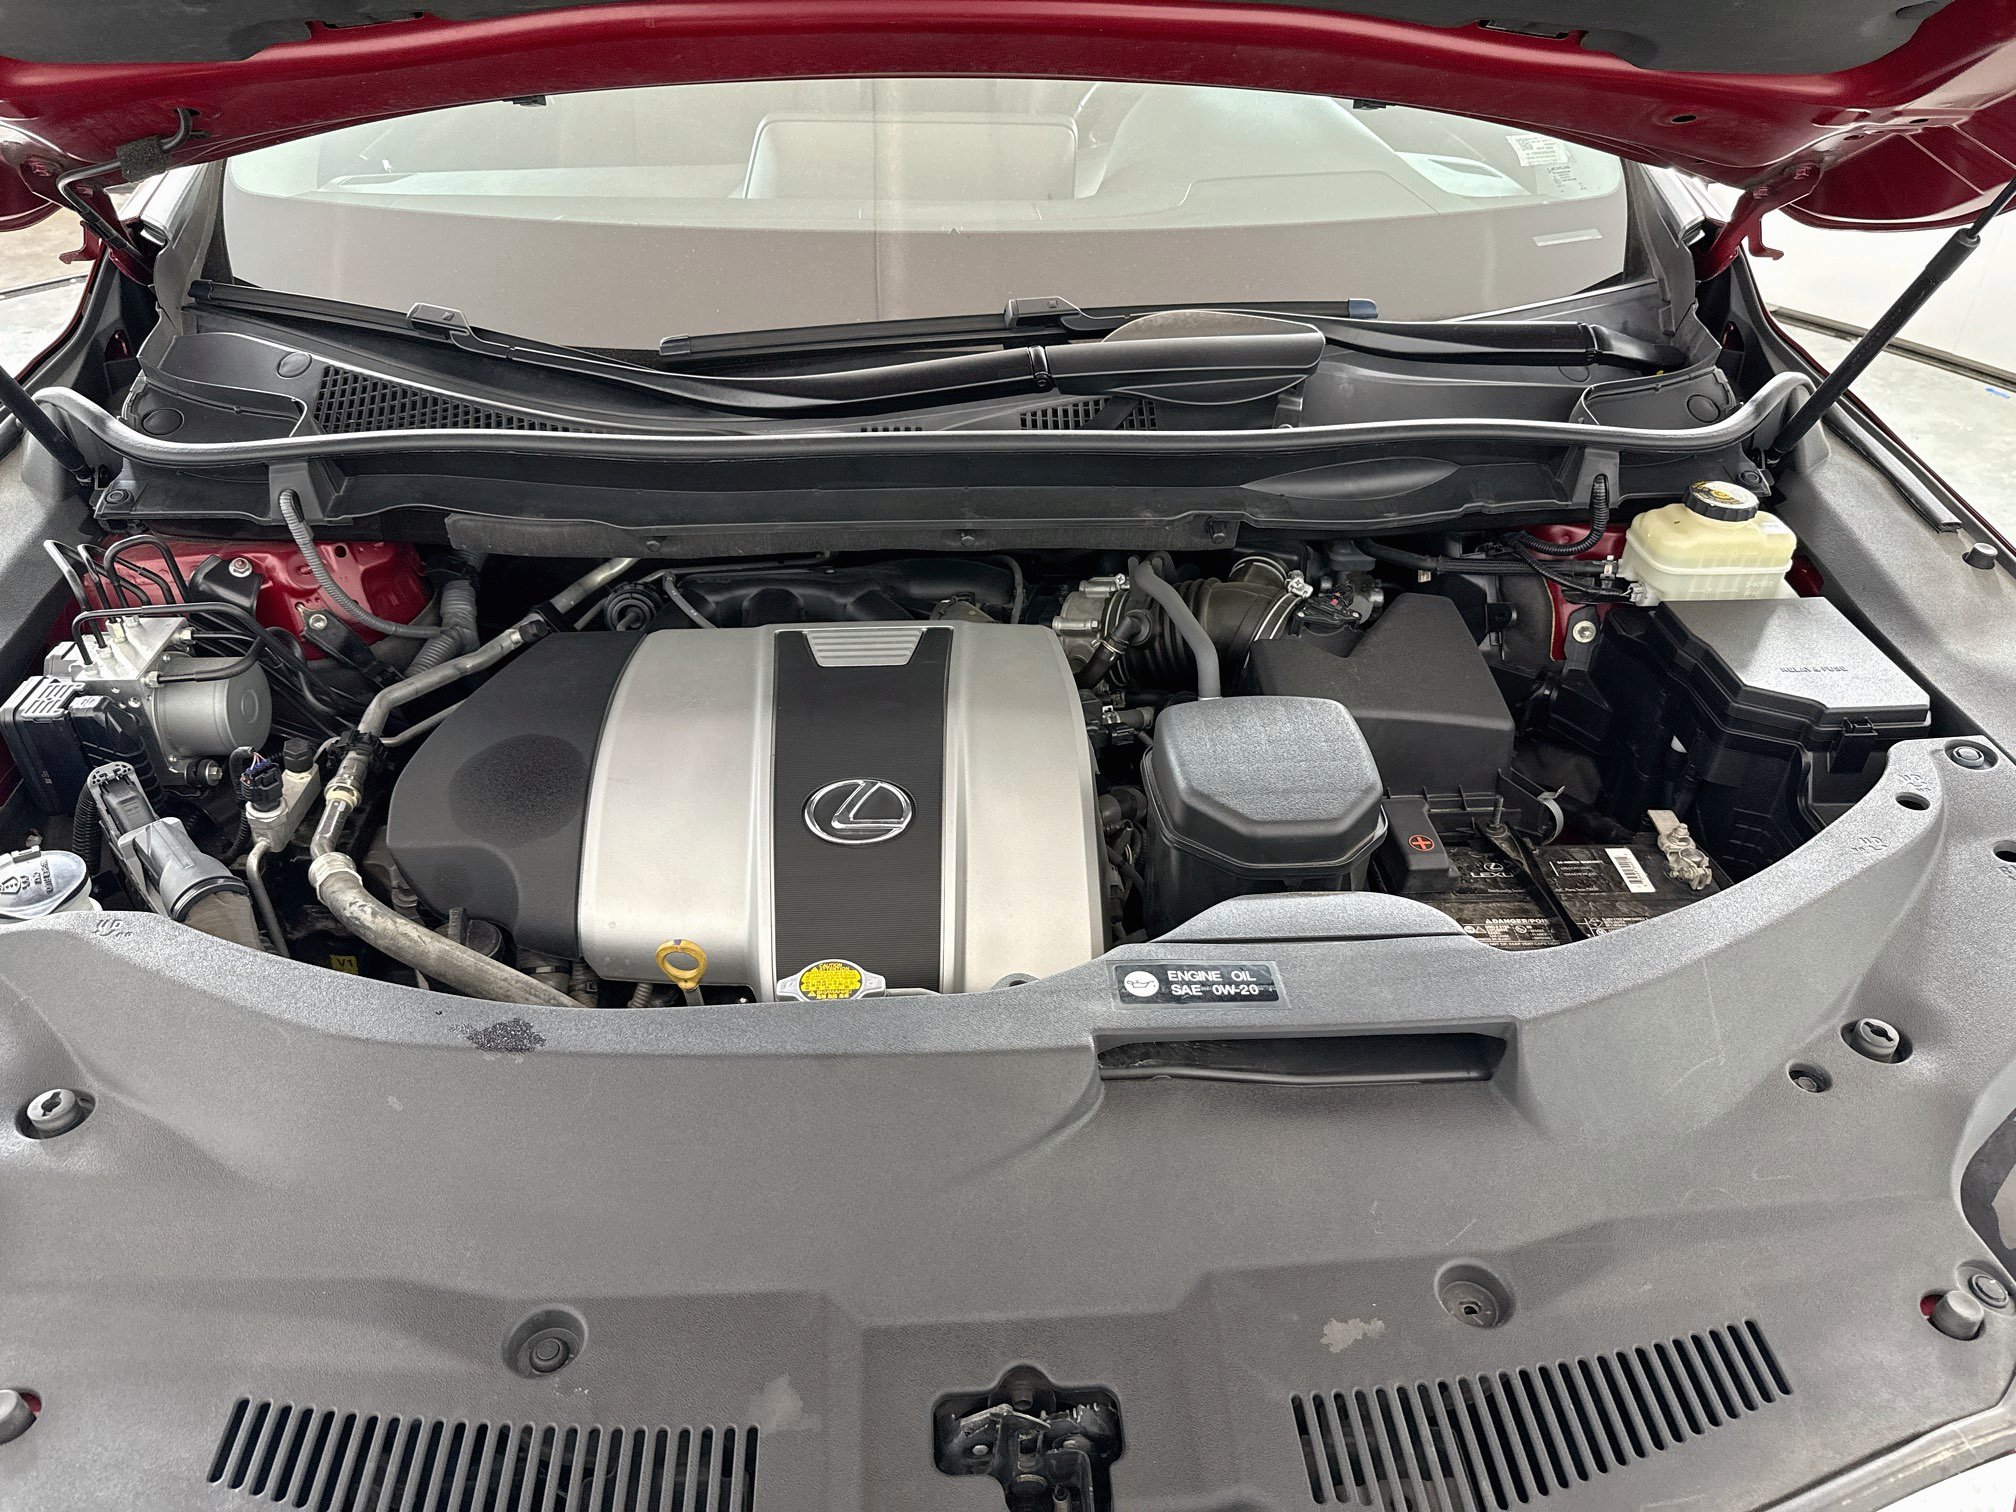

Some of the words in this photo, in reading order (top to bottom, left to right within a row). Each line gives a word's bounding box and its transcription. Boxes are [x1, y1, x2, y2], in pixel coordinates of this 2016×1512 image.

[1167, 970, 1222, 982] ENGINE
[1231, 970, 1256, 982] OIL
[1171, 984, 1202, 996] SAE
[1212, 984, 1259, 996] 0W-20
